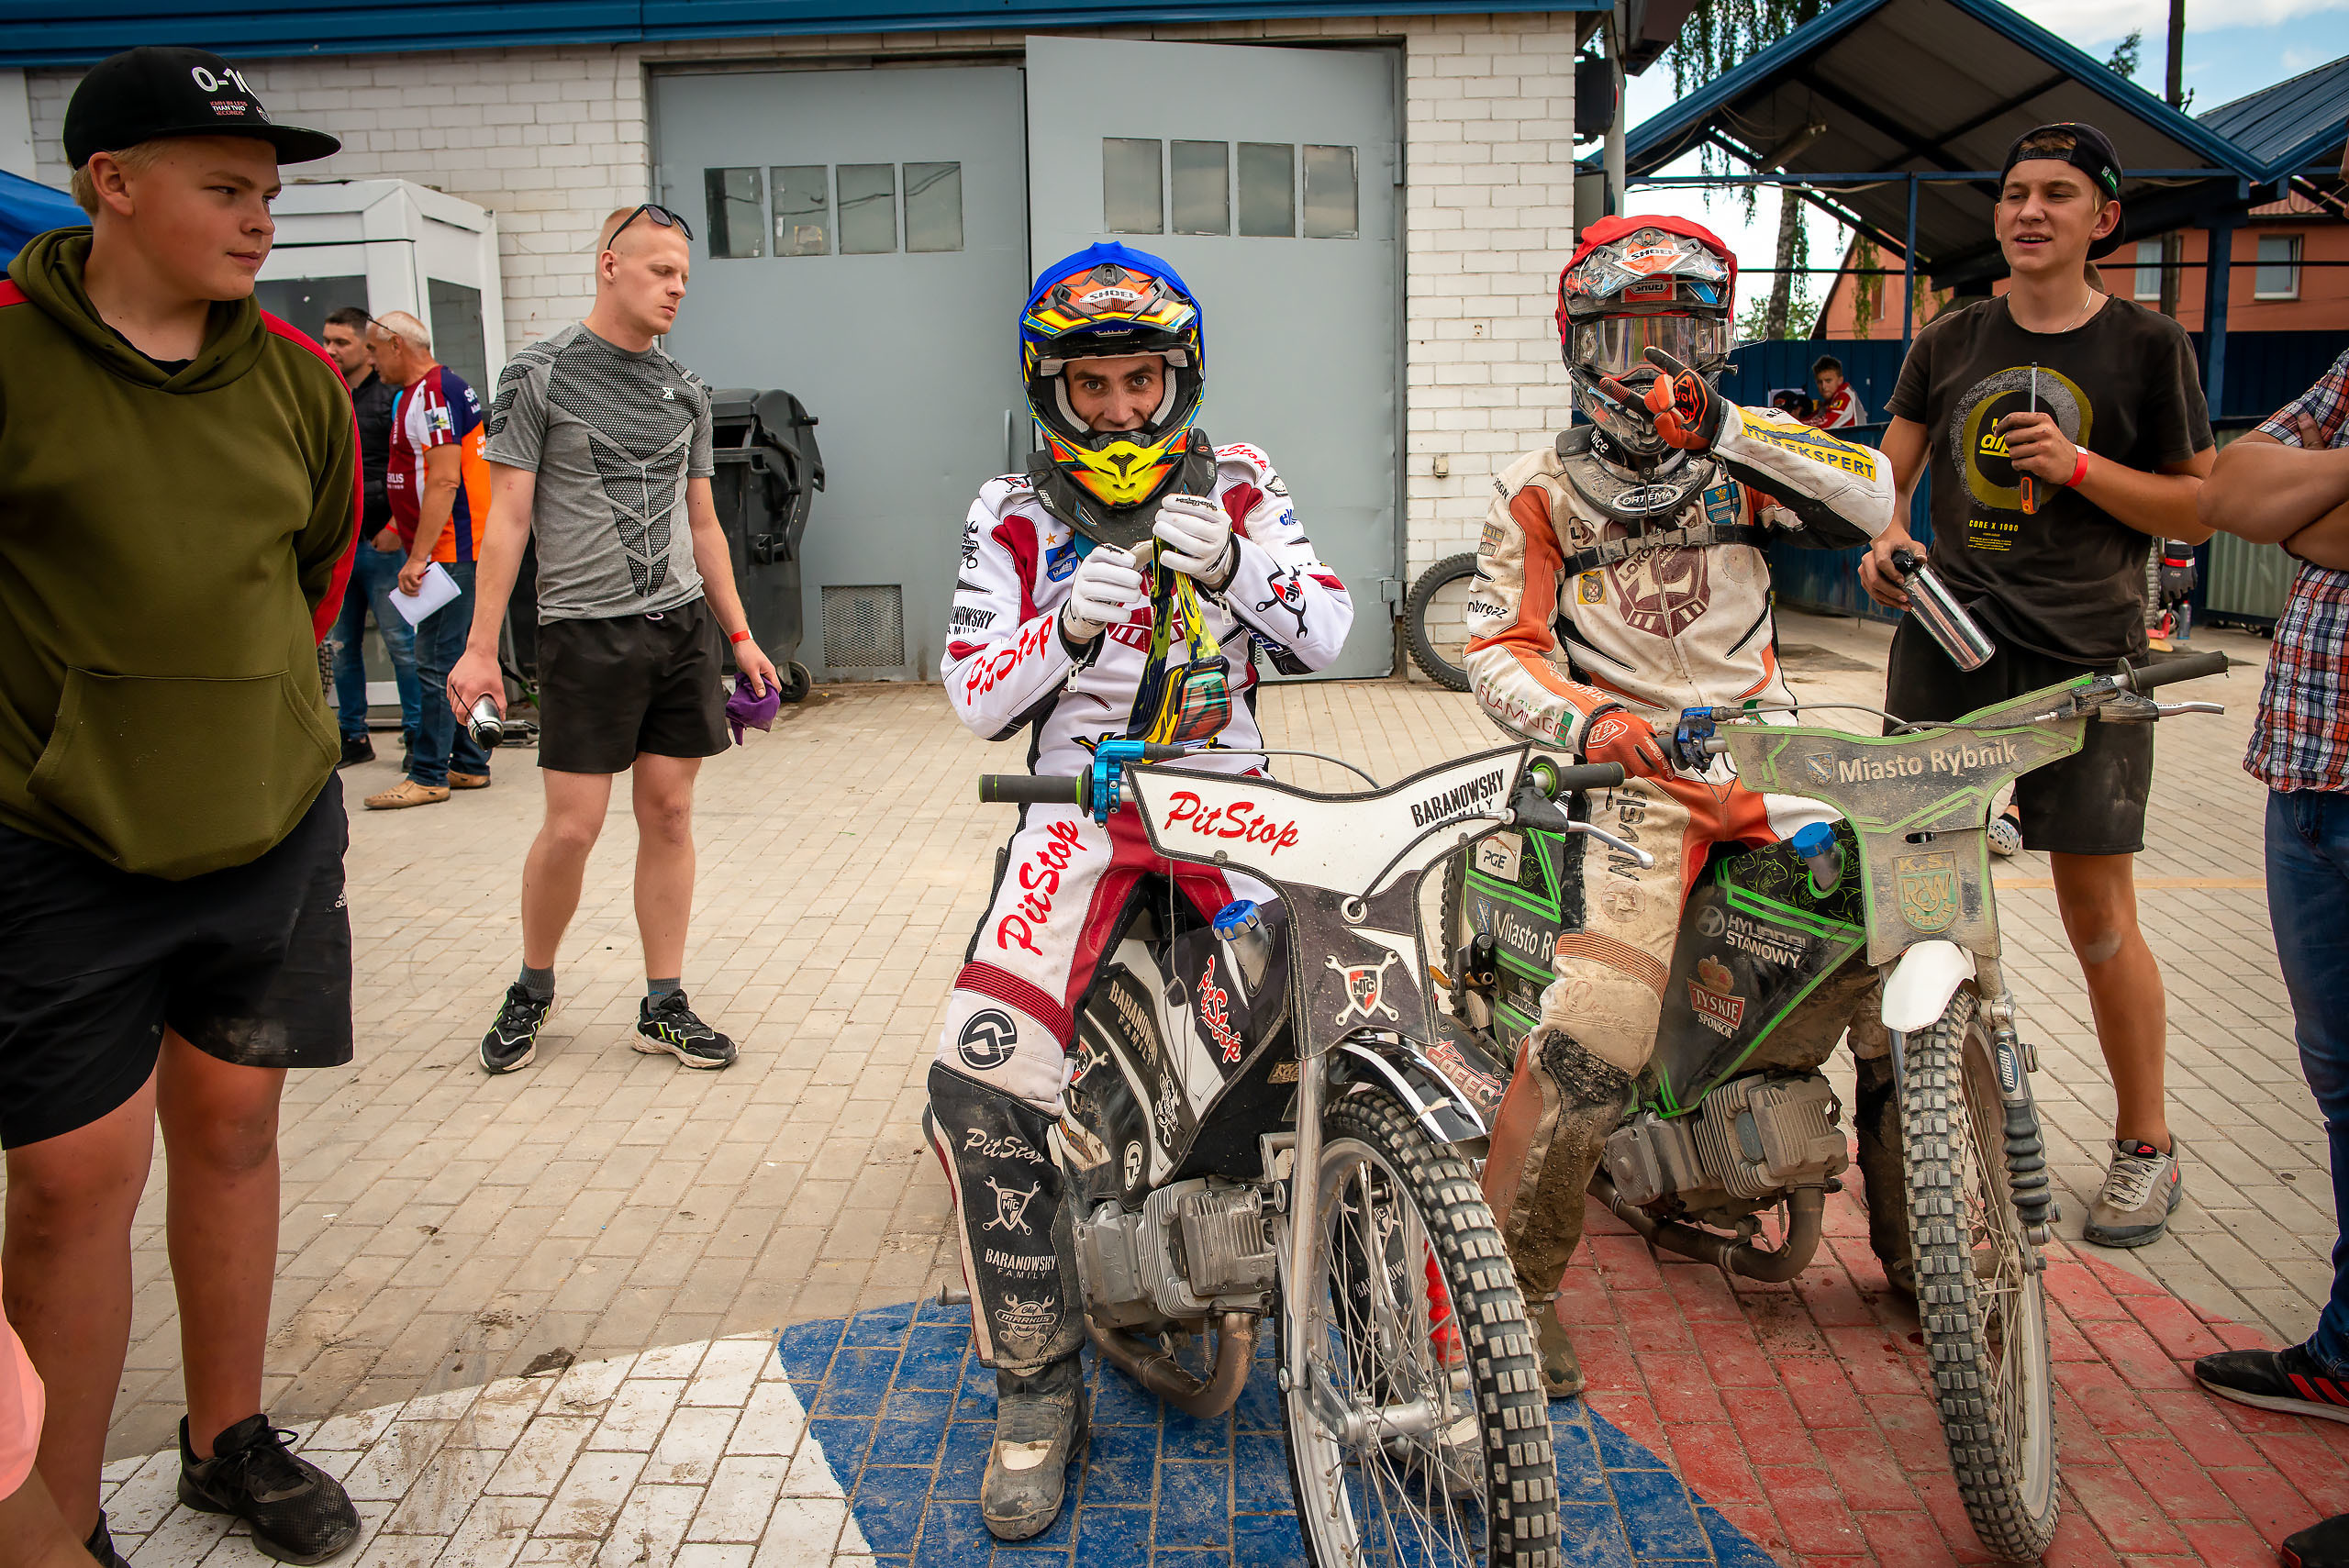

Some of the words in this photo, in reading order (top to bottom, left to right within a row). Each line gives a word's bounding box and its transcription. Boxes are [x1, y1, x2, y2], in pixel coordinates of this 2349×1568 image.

[1631, 248, 1674, 261] SHOEI
[1590, 428, 1609, 453] Nice
[1622, 490, 1674, 504] ORTEMA
[1968, 519, 1988, 529] CORE
[1837, 753, 1923, 784] Miasto
[1930, 738, 2020, 777] Rybnik
[1409, 768, 1505, 828] BARANOWSKY
[1163, 791, 1300, 856] PitStop
[1483, 849, 1508, 871] PGE
[996, 819, 1088, 957] PitStop
[1493, 909, 1539, 956] Miasto
[1725, 929, 1800, 969] STAWOWY
[1196, 953, 1243, 1064] PitStop
[1692, 986, 1740, 1022] TYSKIE
[1698, 1012, 1733, 1040] SPONSOR
[963, 1128, 1045, 1165] PitStop
[1002, 1197, 1020, 1211] MTC
[985, 1248, 1056, 1272] BARANOWSKY
[996, 1267, 1047, 1280] FAMILY
[1000, 1313, 1051, 1323] MARKUS
